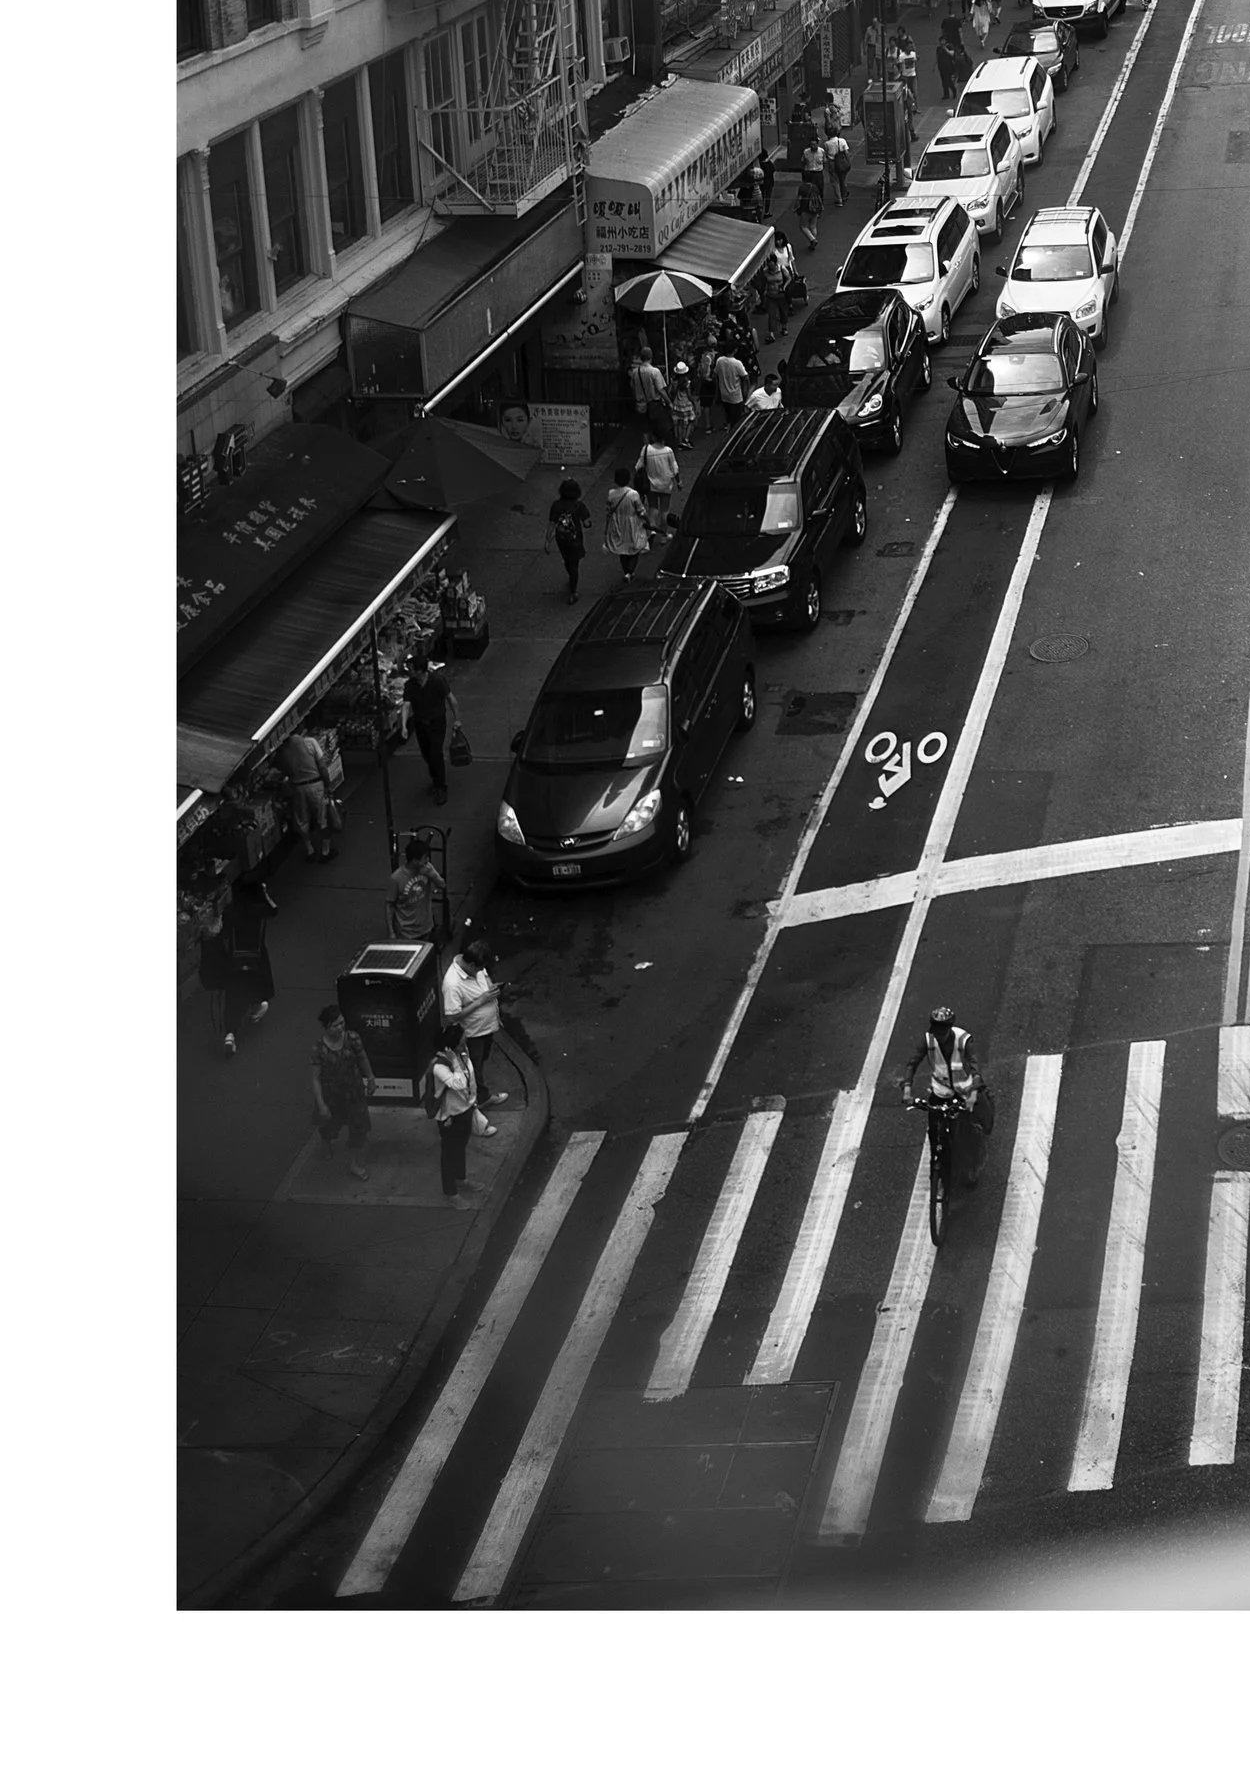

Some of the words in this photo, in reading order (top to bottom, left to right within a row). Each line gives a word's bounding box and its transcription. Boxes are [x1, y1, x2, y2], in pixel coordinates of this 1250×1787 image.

[596, 226, 649, 240] 福州小吃店
